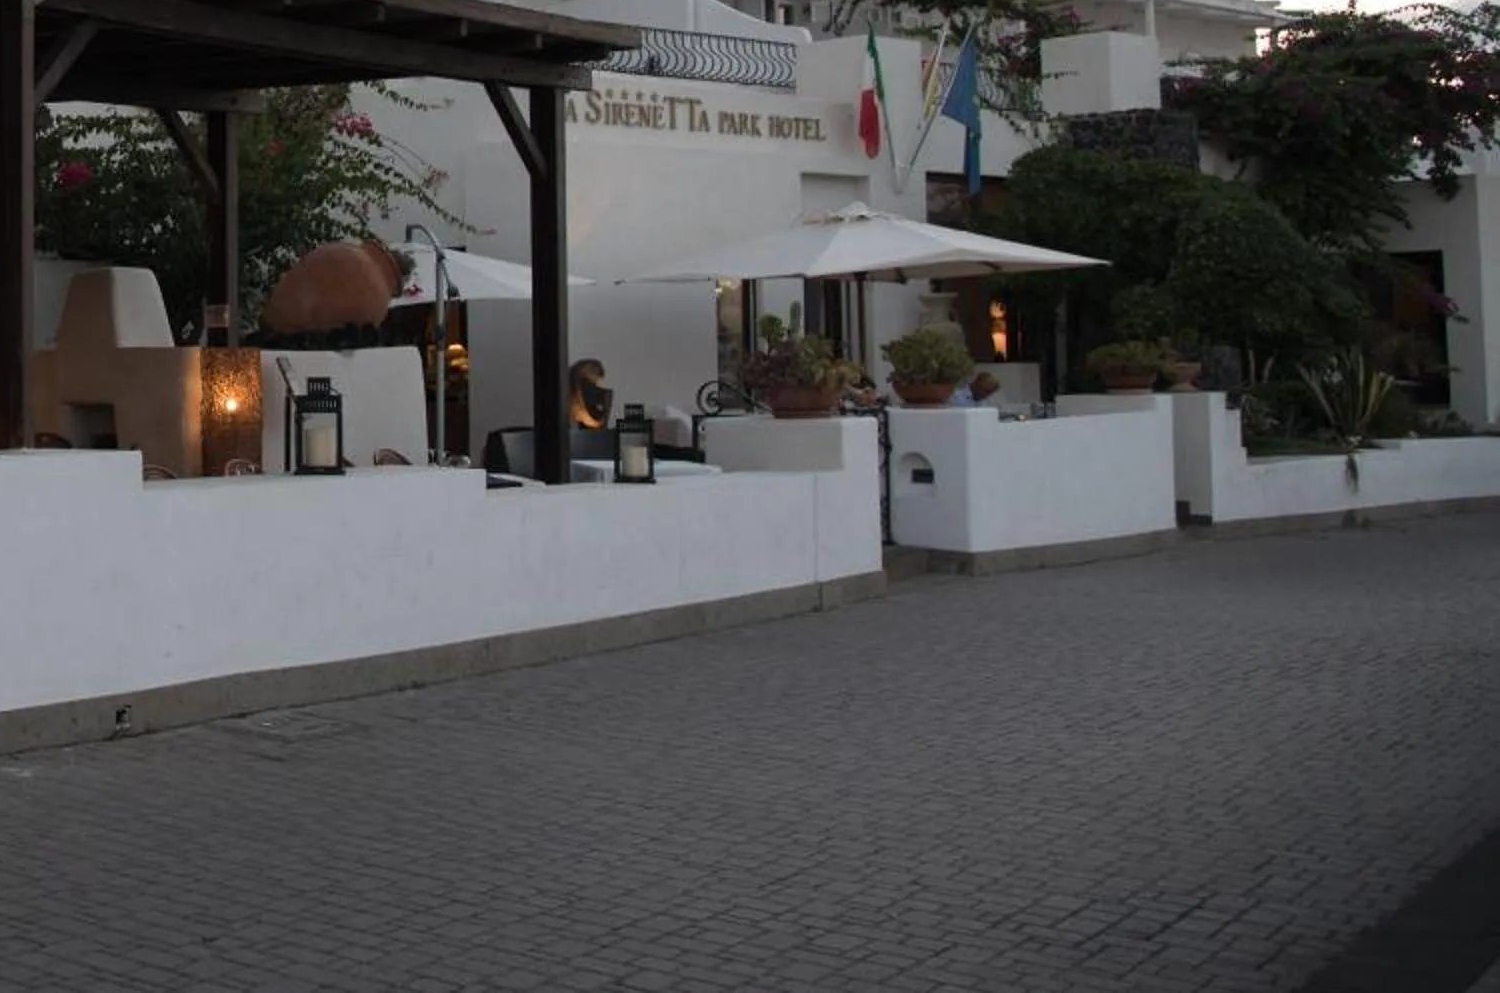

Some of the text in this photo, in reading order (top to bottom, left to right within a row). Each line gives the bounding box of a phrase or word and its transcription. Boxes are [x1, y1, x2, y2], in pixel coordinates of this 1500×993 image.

[564, 98, 578, 124] A
[718, 110, 762, 138] PARK
[768, 115, 827, 141] HOTEL
